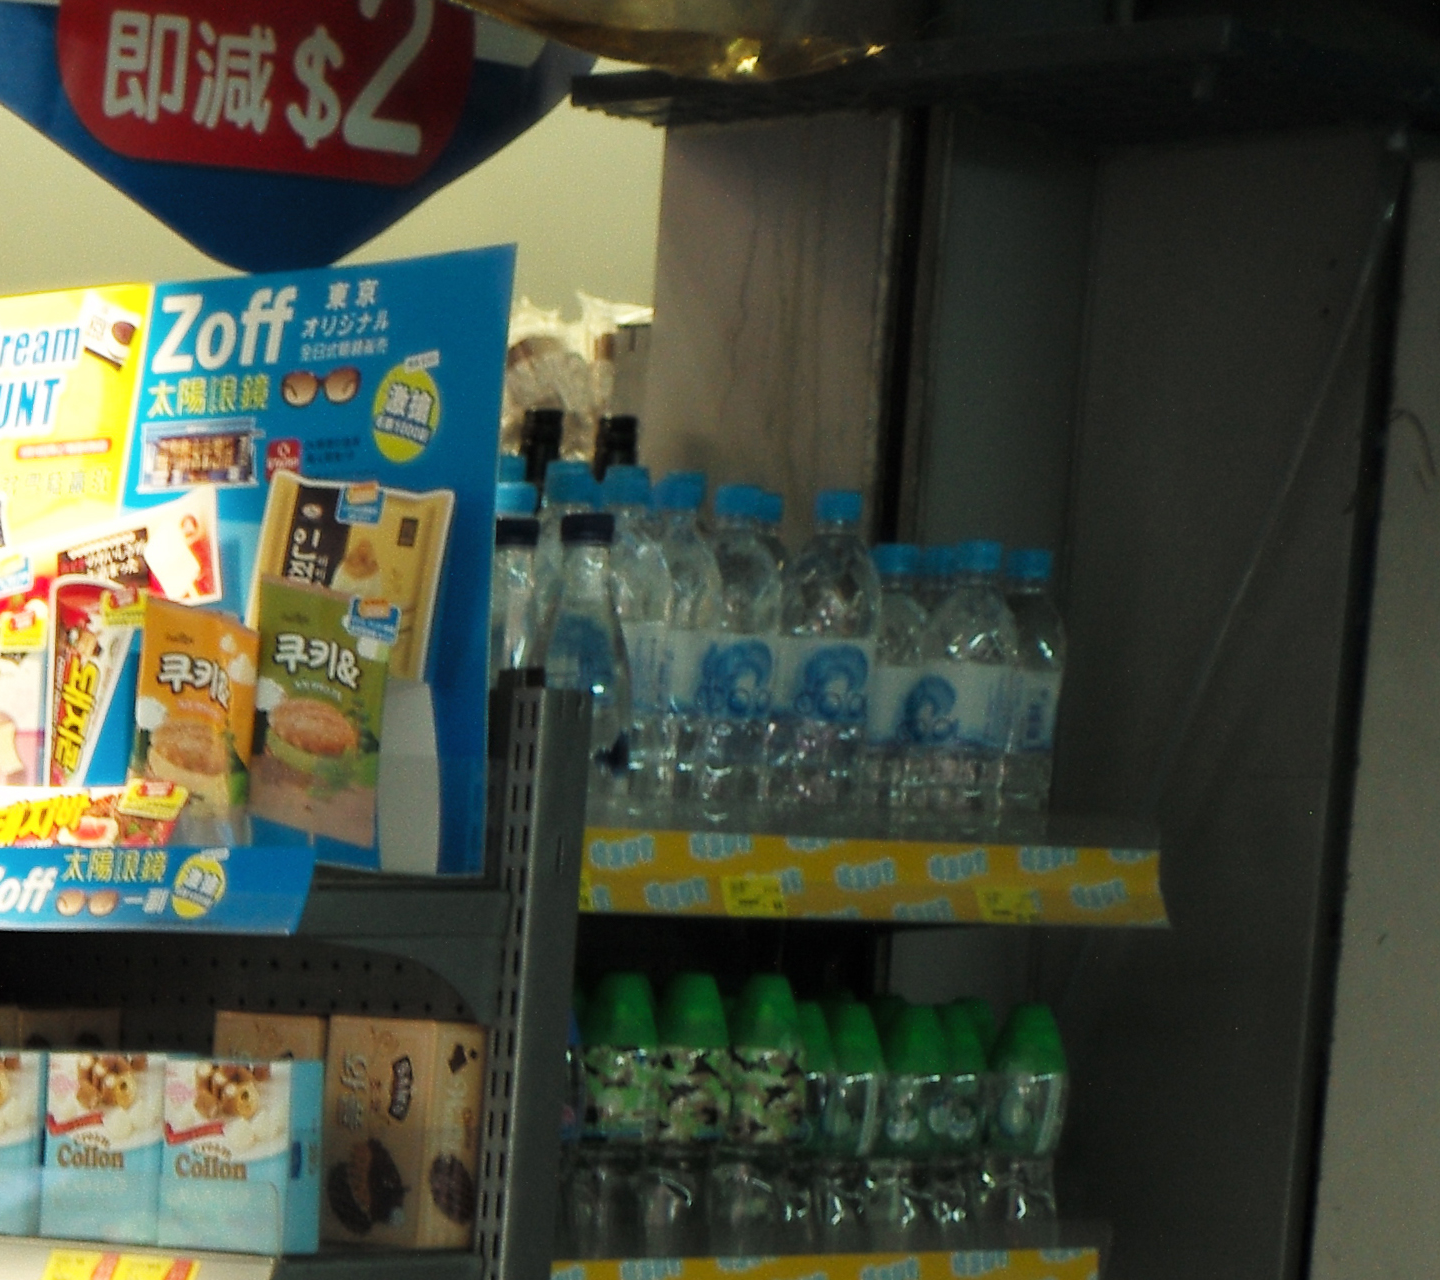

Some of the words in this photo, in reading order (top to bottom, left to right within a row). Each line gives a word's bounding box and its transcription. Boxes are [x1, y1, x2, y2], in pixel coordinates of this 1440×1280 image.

[326, 280, 382, 309] 東京
[151, 288, 298, 375] Zoff
[147, 375, 270, 419] 太陽眼鏡
[56, 1144, 125, 1171] Collon
[175, 1153, 250, 1185] Collon
